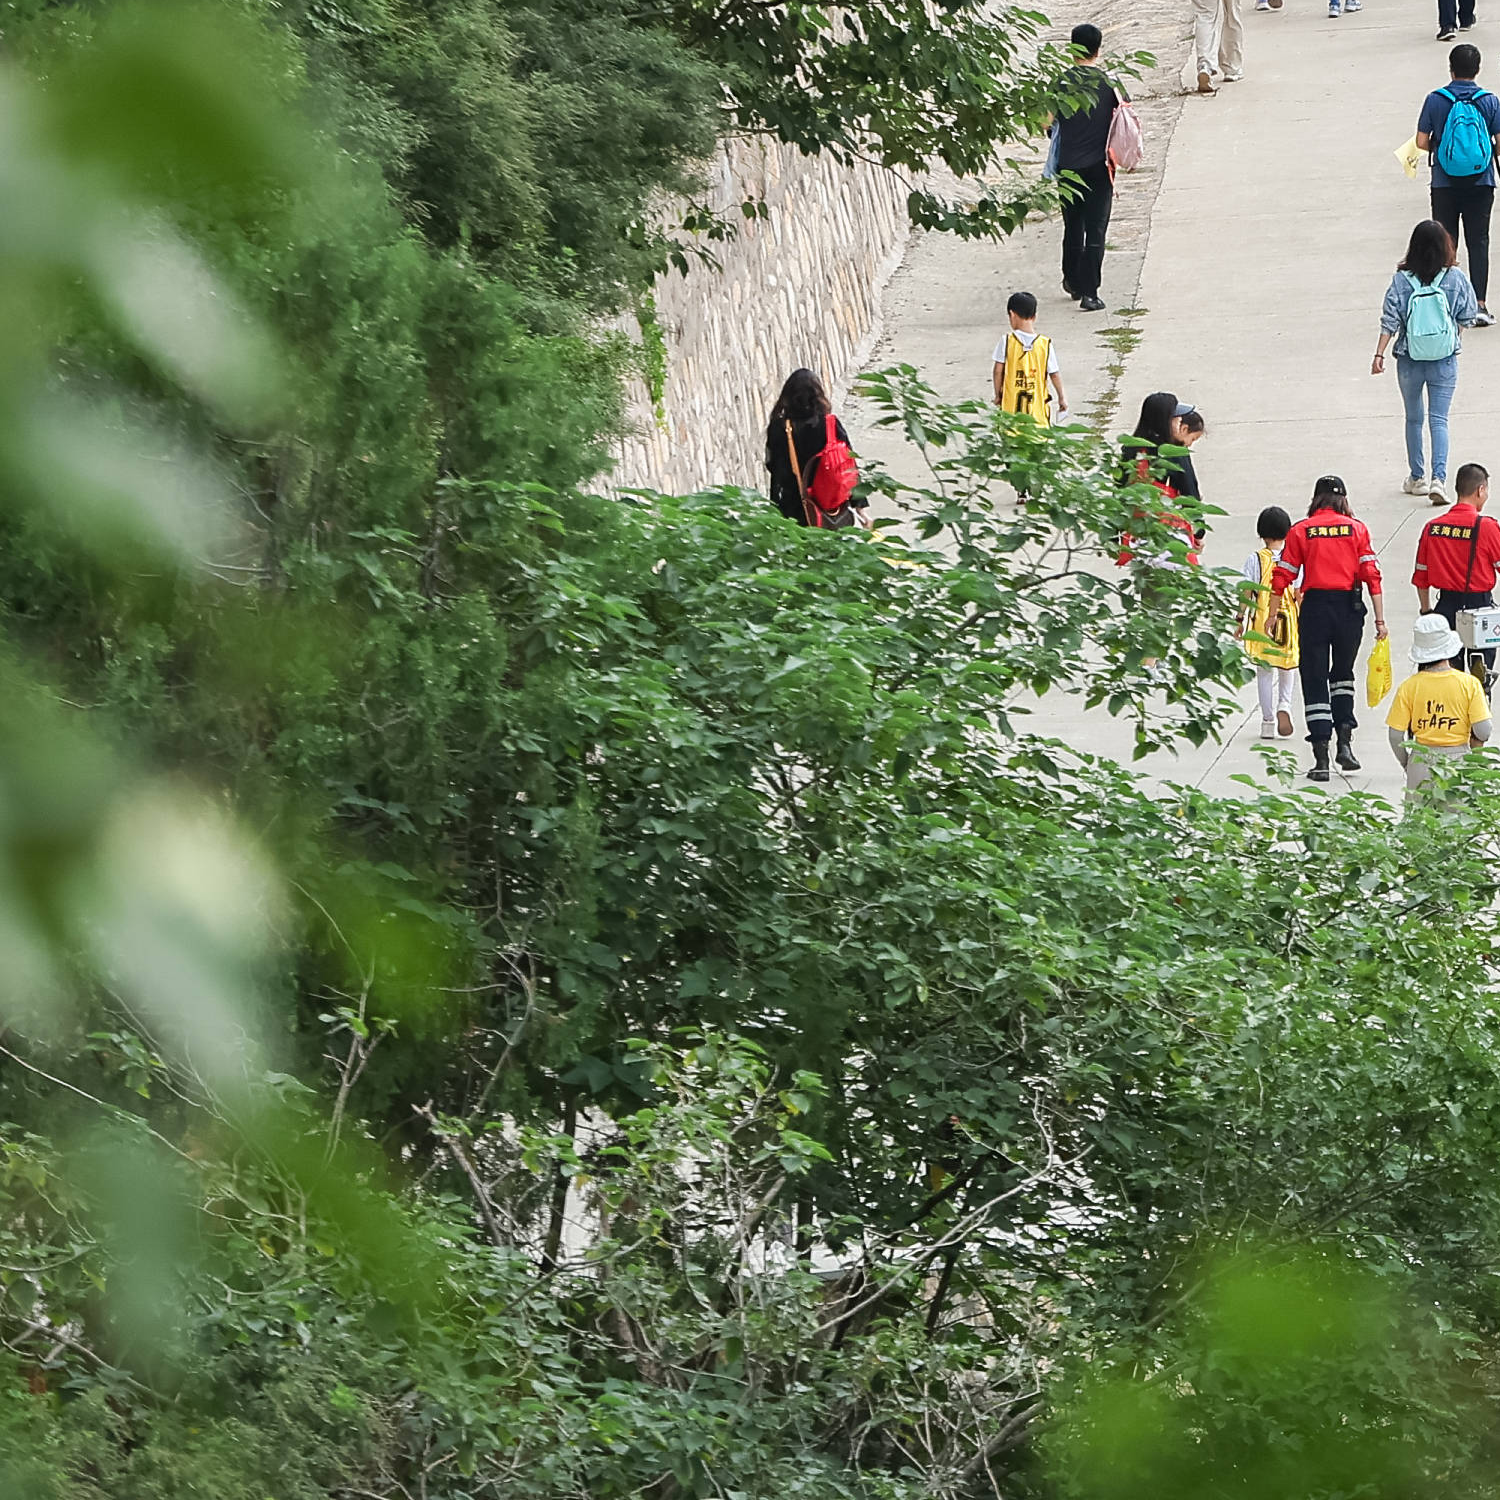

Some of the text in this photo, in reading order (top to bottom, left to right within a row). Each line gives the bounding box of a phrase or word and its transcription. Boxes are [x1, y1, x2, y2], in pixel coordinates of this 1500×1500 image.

[1431, 524, 1472, 539] 天海救援
[1427, 700, 1444, 714] I'm
[1417, 714, 1460, 730] STAFF
